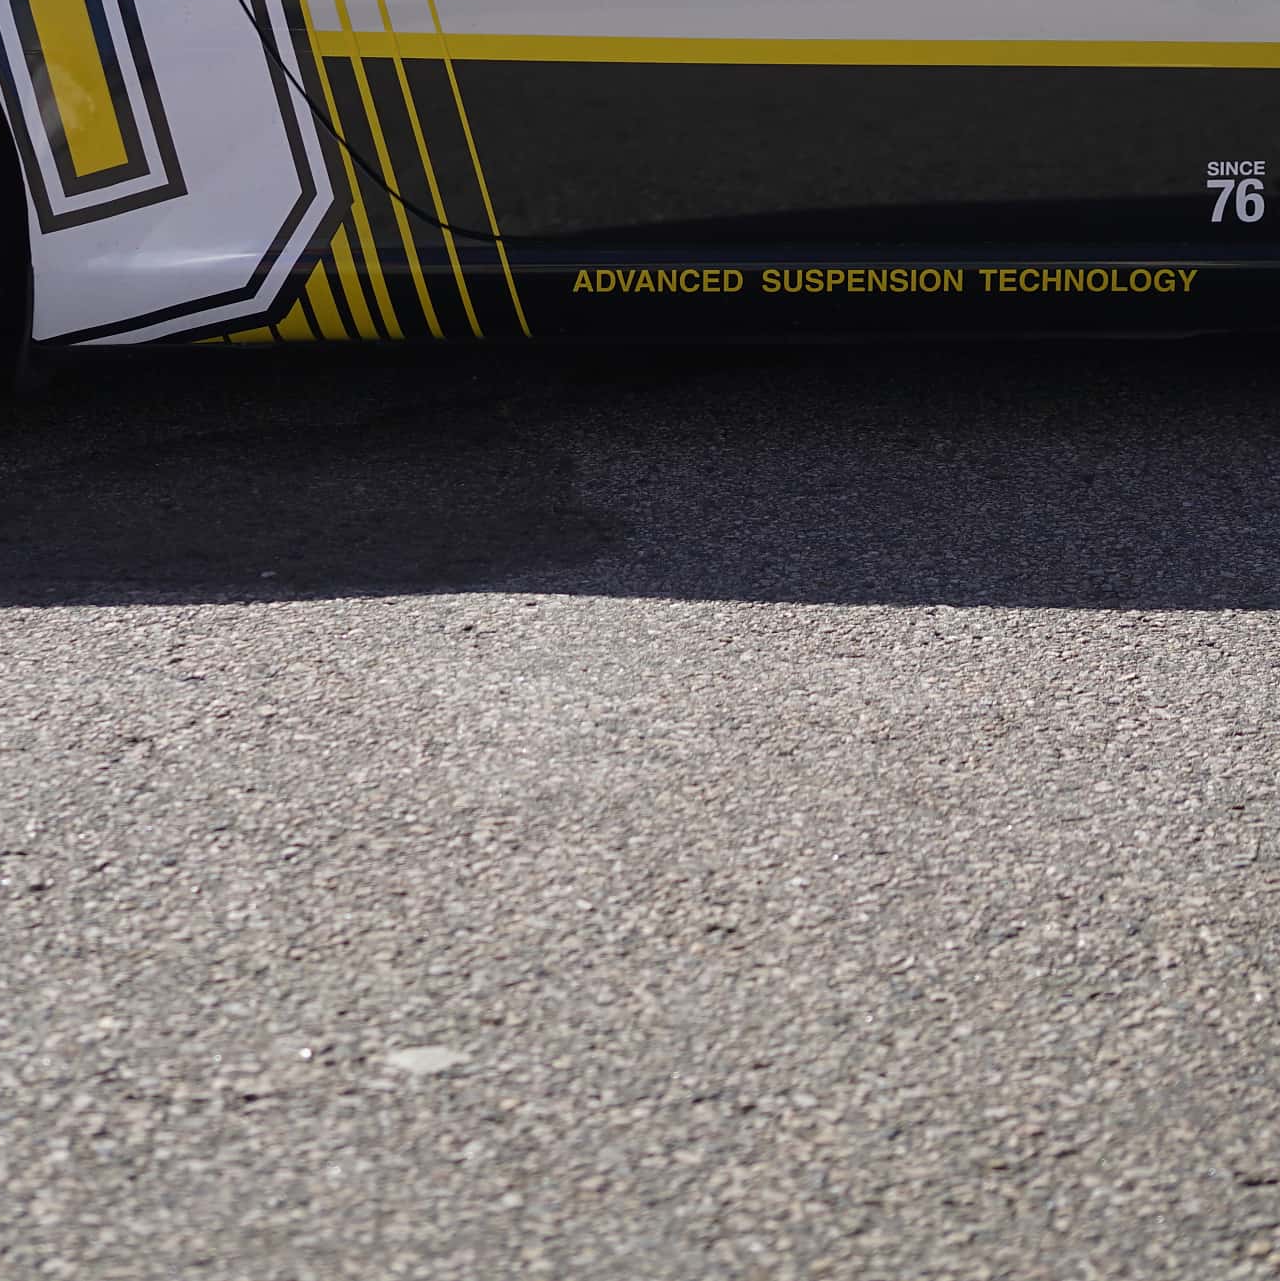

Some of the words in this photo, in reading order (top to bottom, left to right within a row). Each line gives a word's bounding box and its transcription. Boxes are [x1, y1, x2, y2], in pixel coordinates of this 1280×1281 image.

[1207, 161, 1266, 176] SINCE
[1207, 178, 1265, 223] 76
[572, 269, 744, 293] ADVANCED
[761, 269, 965, 293] SUSPENSION
[979, 269, 1199, 293] TECHNOLOGY
